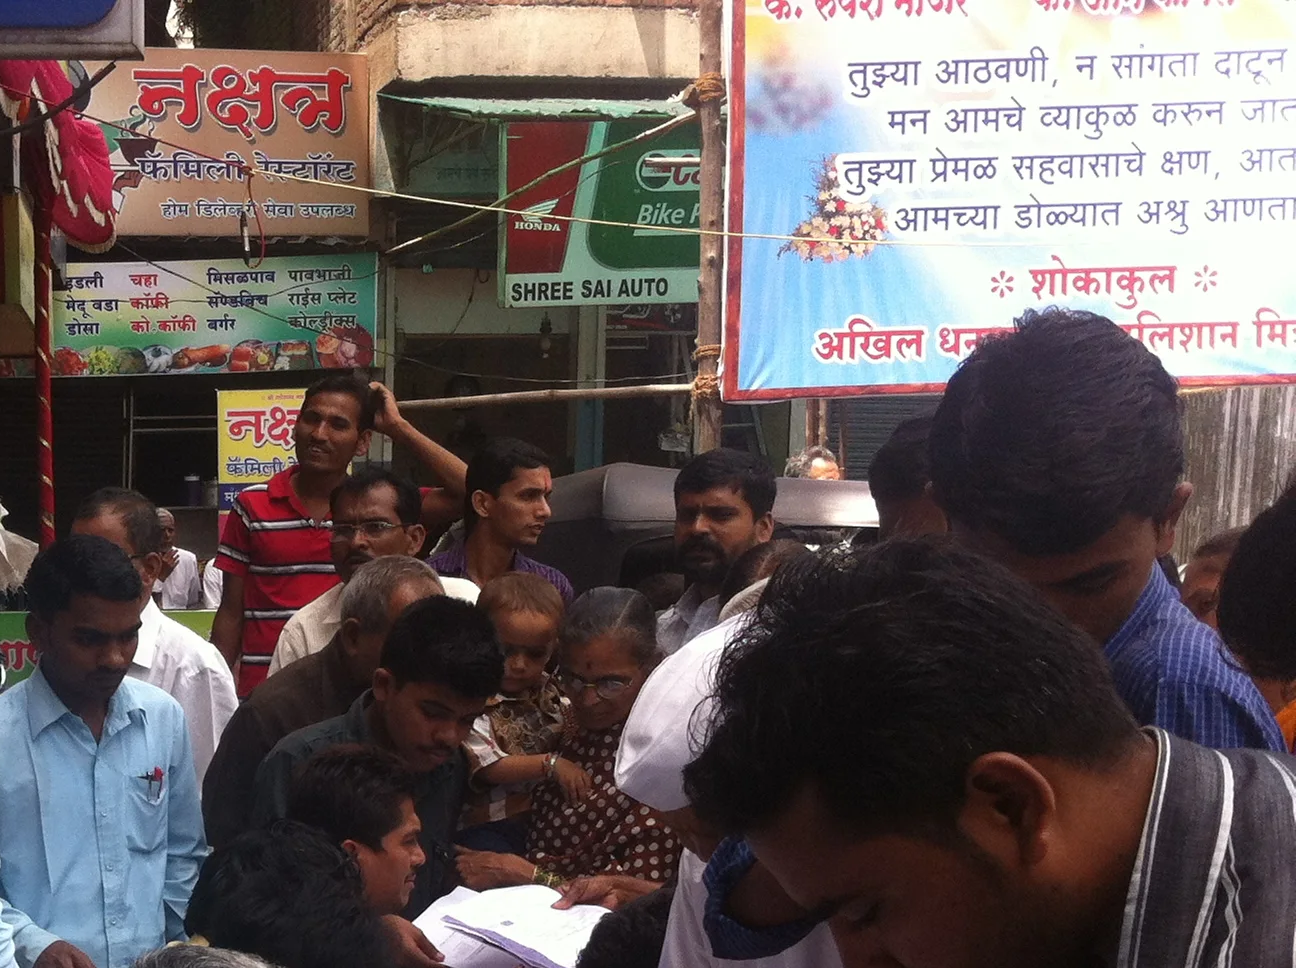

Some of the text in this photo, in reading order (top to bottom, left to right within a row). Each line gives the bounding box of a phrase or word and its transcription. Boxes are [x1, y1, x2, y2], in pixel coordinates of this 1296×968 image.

[848, 44, 1288, 98] तुझ्या आठवणी, न सांगता दाटून
[132, 64, 351, 139] नक्षत्र
[887, 109, 930, 135] मन
[945, 97, 1026, 132] आमचे
[1040, 103, 1138, 141] व्याकुळ
[1152, 101, 1226, 126] करुन
[843, 158, 916, 196] तुझ्या
[930, 147, 998, 184] प्रेमळ
[1013, 142, 1146, 187] सहवासाचे
[1161, 150, 1220, 180] क्षण,
[162, 199, 189, 217] होम
[264, 201, 294, 217] सेवा
[301, 204, 356, 217] उपलब्ध
[636, 203, 685, 225] Bike
[895, 205, 1001, 233] आमच्या
[1015, 193, 1121, 230] डोळ्यात
[1137, 200, 1189, 235] अश्रु
[514, 221, 561, 232] HONDA
[129, 273, 158, 287] चहा
[511, 277, 669, 302] SHREE SAI AUTO
[1029, 255, 1177, 309] शोकाकुल
[92, 300, 119, 312] वडा
[326, 290, 358, 307] प्लेट
[65, 318, 100, 335] डोसा
[206, 313, 236, 331] बर्गर
[814, 317, 924, 360] अखिल
